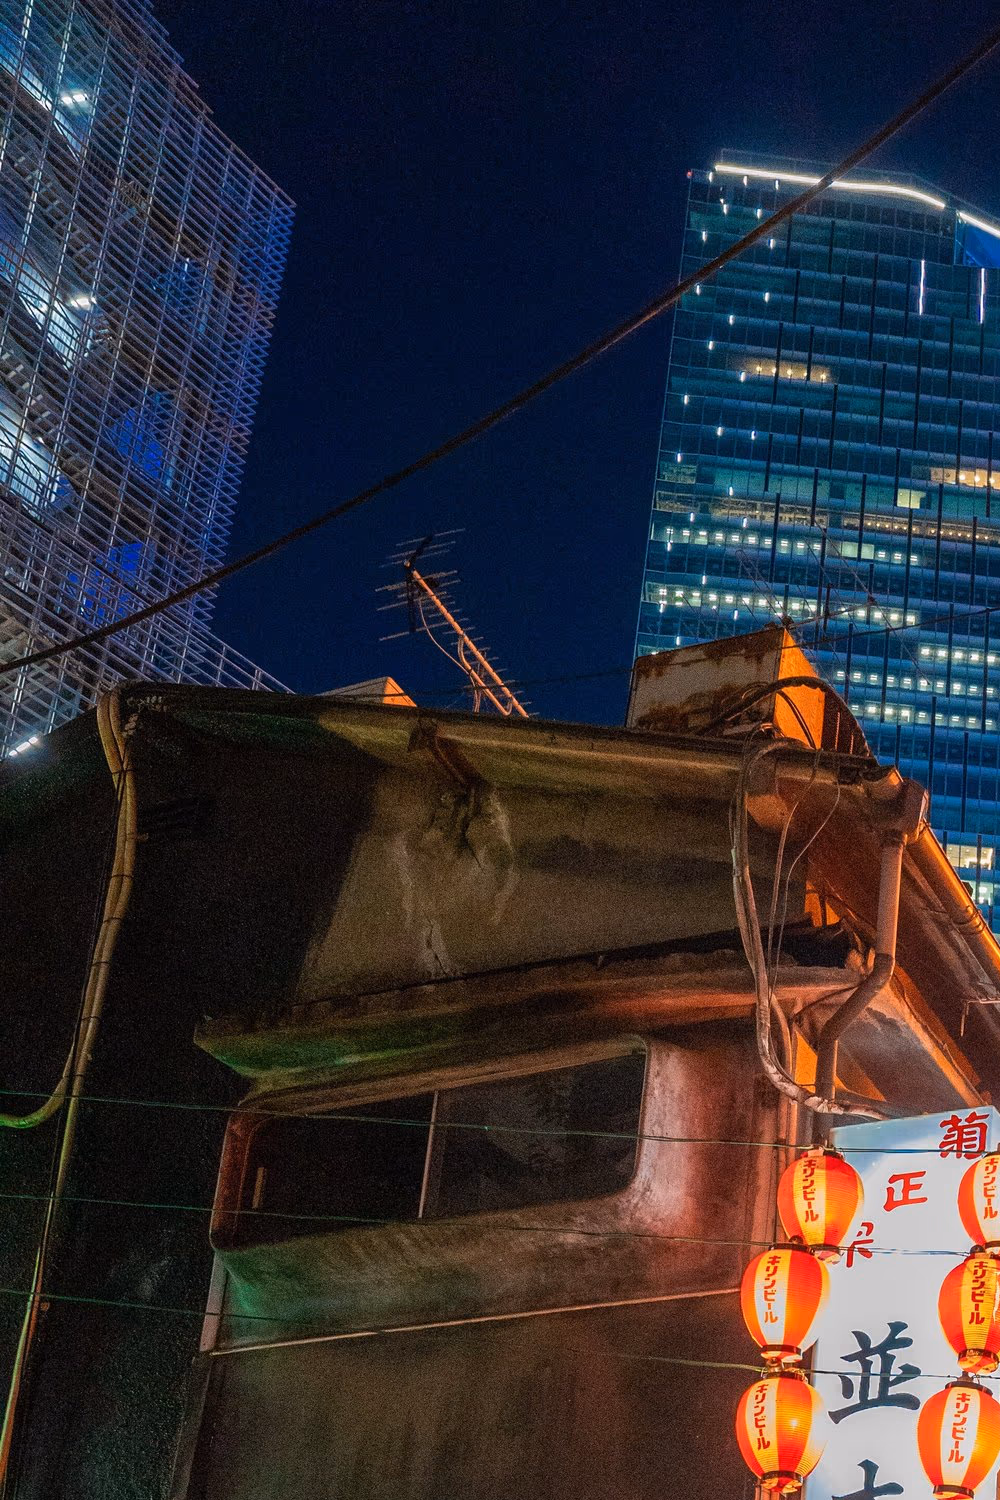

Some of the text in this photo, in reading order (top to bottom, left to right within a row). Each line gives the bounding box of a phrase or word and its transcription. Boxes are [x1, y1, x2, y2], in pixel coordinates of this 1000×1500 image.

[801, 1157, 818, 1222] キリンビール
[984, 1157, 998, 1220] キリンビール
[765, 1256, 779, 1324] キリンビール
[972, 1260, 986, 1325] キリンビール
[754, 1384, 770, 1450] キリンビール
[948, 1393, 966, 1464] キリンビール
